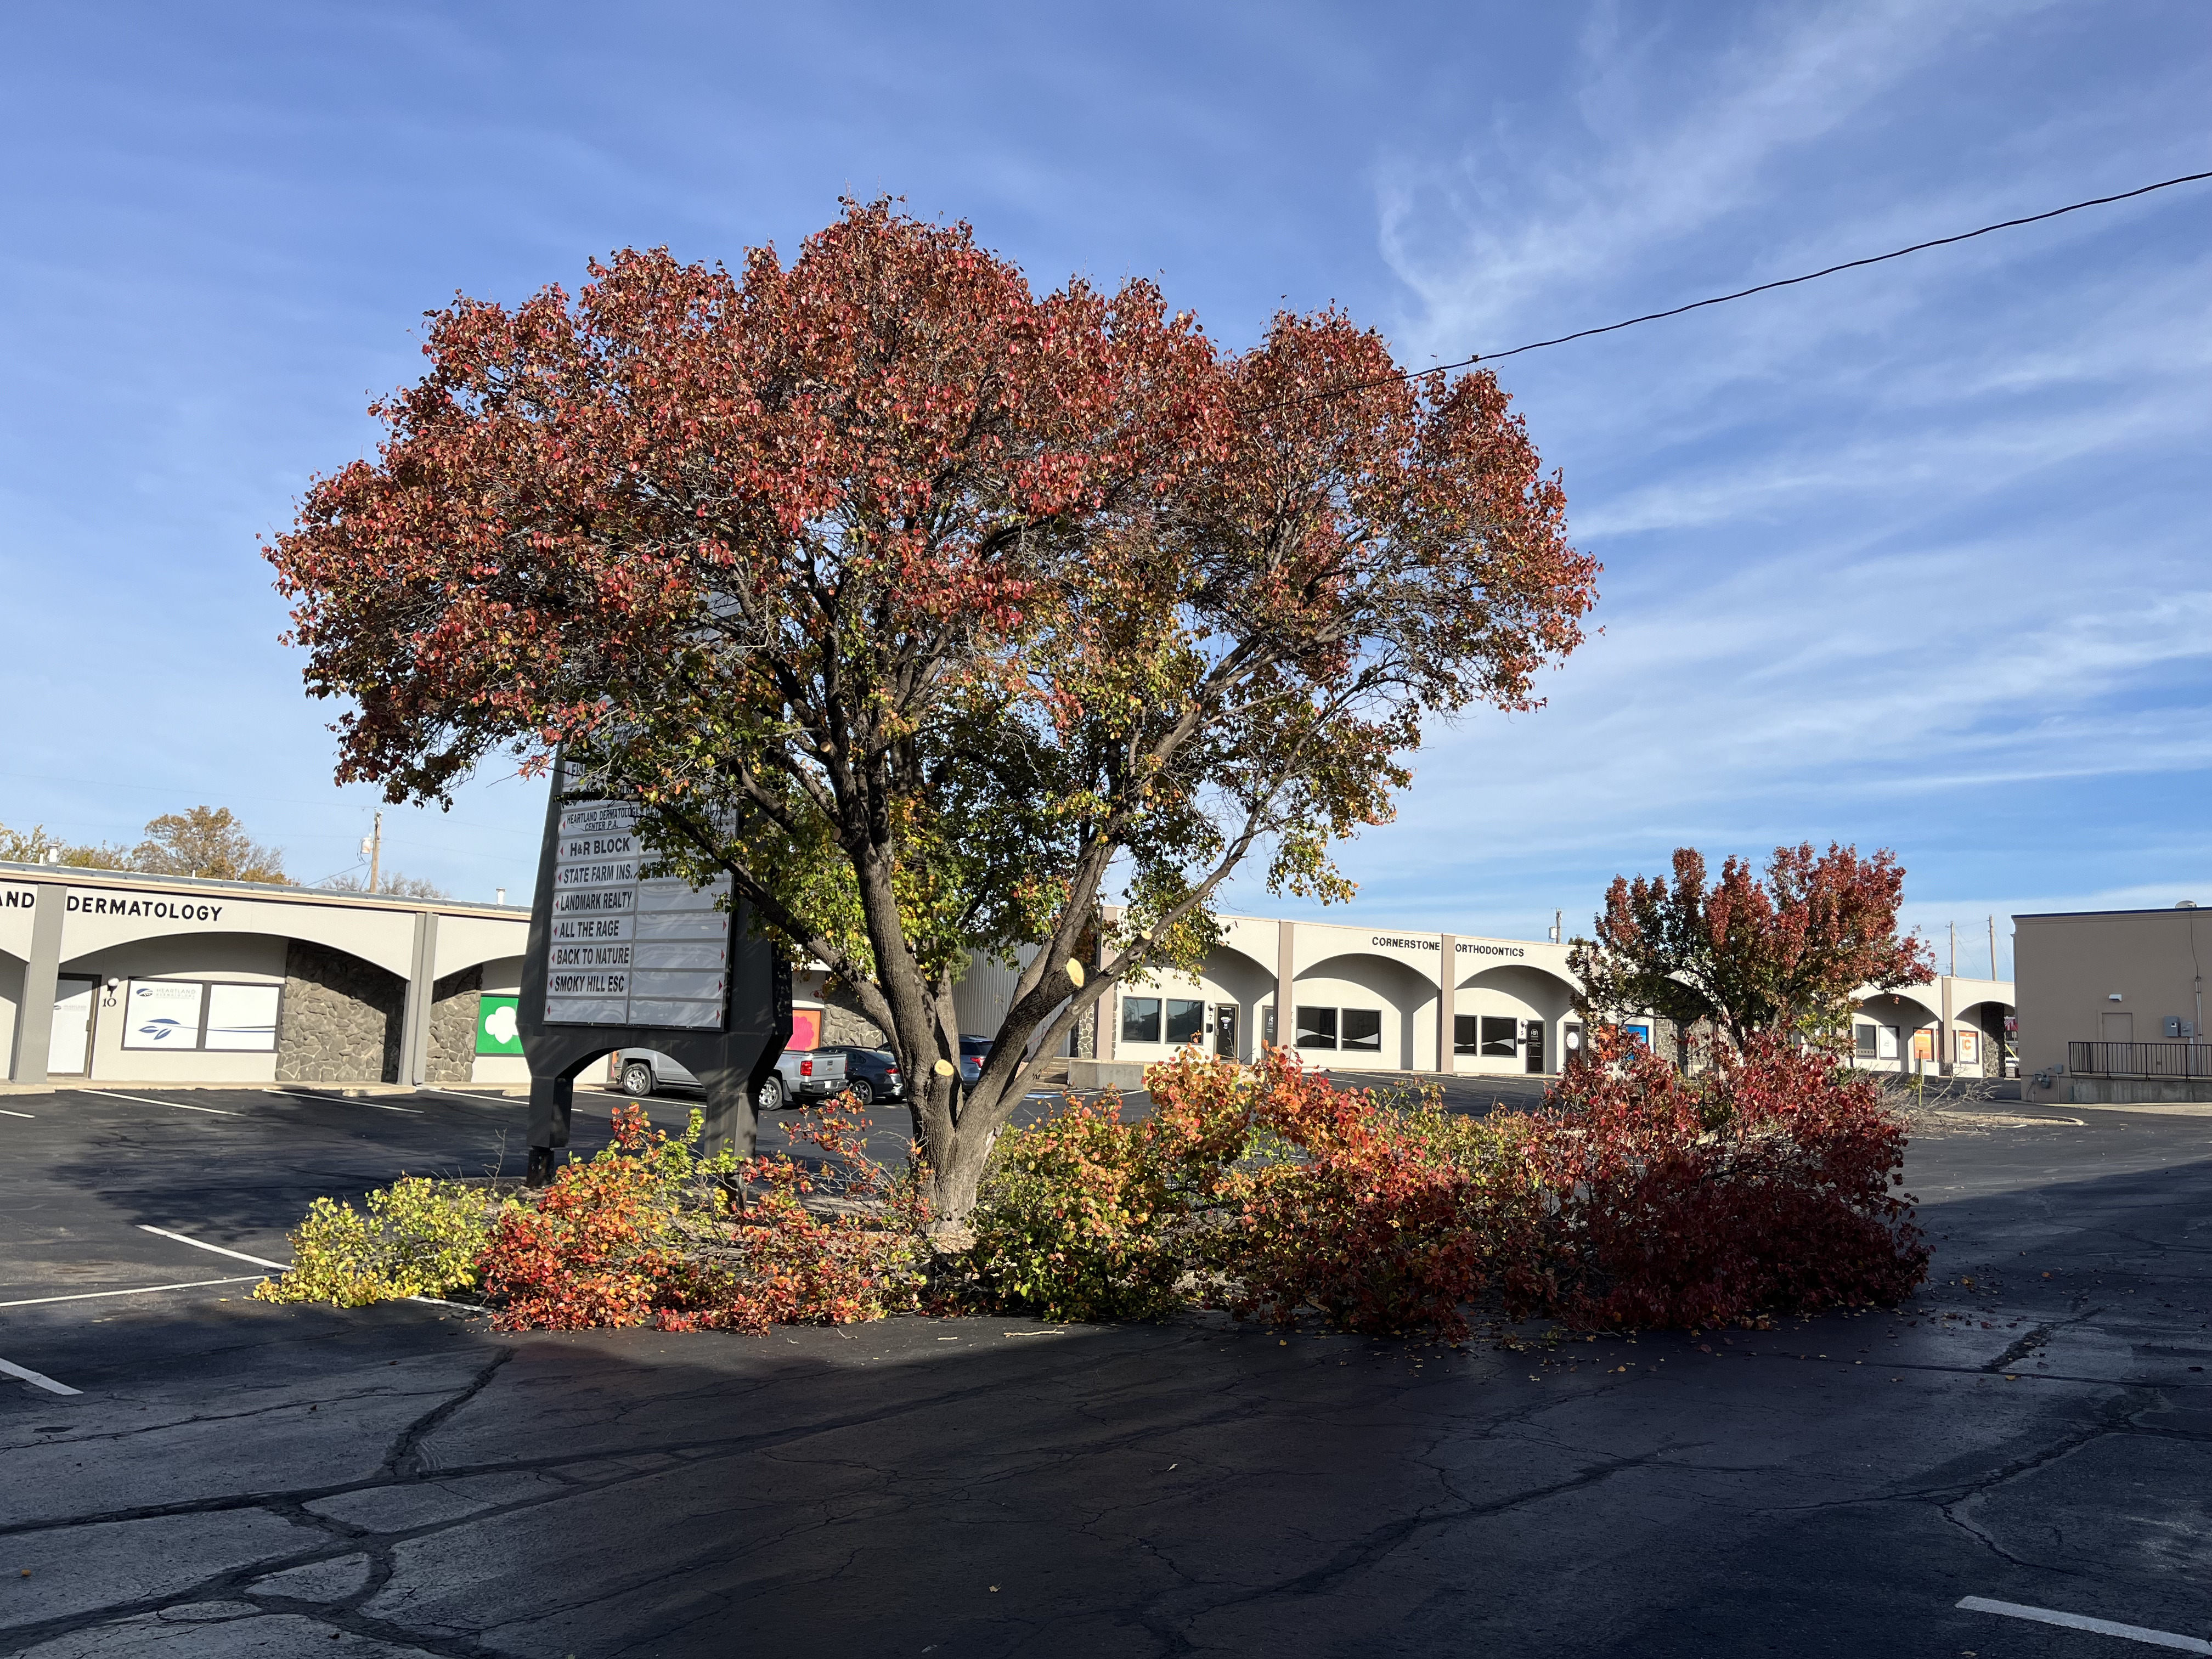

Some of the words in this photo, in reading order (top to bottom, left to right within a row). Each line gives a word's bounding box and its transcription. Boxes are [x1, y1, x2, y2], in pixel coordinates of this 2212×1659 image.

[567, 811, 597, 824] HEARTLAND
[599, 806, 639, 820] DERMATOLOGY
[585, 821, 606, 831] CENTER
[607, 820, 618, 830] P.A.
[569, 842, 590, 856] H&R
[594, 837, 630, 854] BLOCK
[563, 867, 589, 884] STATE
[591, 865, 614, 882] FARM
[616, 864, 633, 880] INS.
[0, 891, 35, 908] ND
[66, 895, 222, 921] DERMATOLOGY
[561, 893, 601, 911] LANDMARK
[603, 891, 632, 909] REALTY
[559, 922, 574, 938] ALL
[578, 921, 594, 937] THE
[596, 920, 619, 936] RAGE
[557, 949, 580, 964] BACK
[583, 948, 593, 964] TO
[595, 947, 629, 964] NATURE
[1372, 936, 1440, 951] CORNERSTONE
[1455, 944, 1524, 957] ORTHODONTICS
[555, 975, 585, 992] SMOKY
[586, 976, 605, 992] HILL
[607, 975, 624, 992] ESC
[103, 998, 117, 1007] 10
